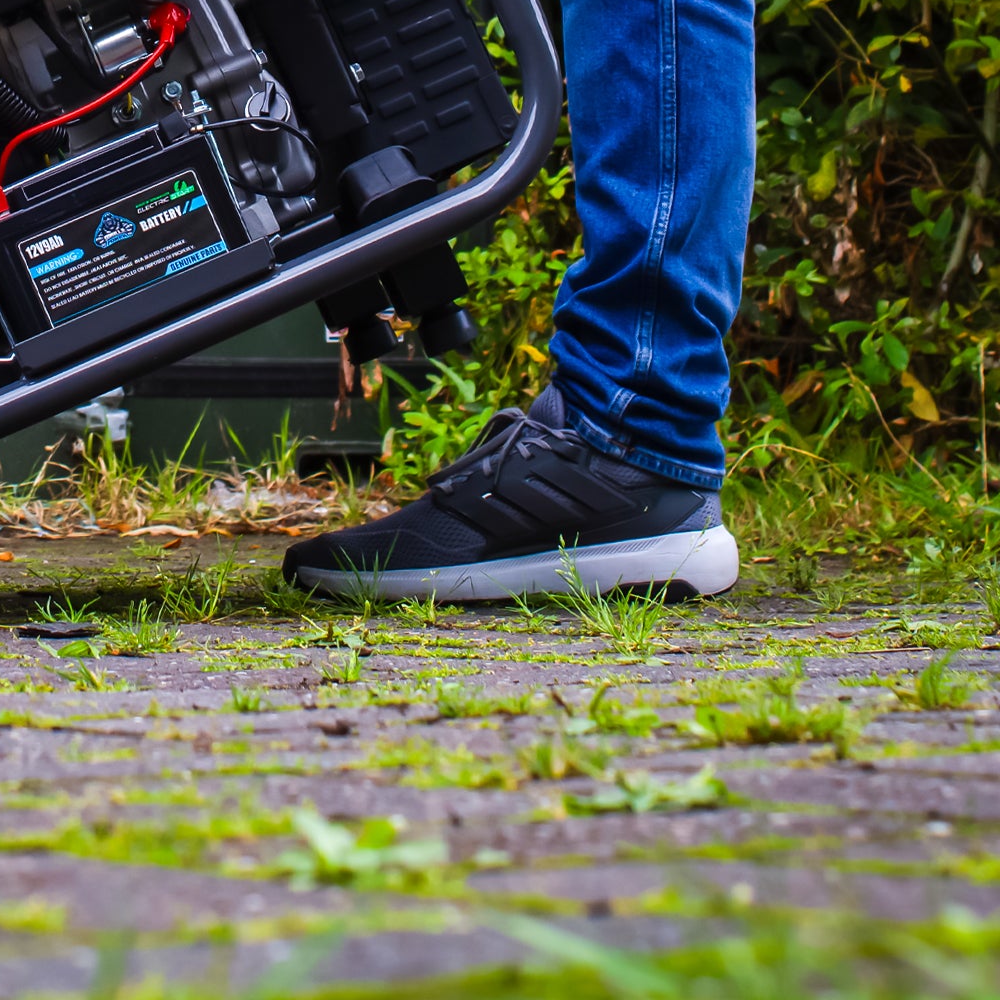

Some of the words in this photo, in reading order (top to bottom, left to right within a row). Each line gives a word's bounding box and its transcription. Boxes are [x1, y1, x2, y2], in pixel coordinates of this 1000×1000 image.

[139, 205, 182, 232] BATTERY
[25, 234, 64, 260] 12V9Ah
[170, 254, 202, 271] GENUINE
[201, 243, 223, 258] PARTS
